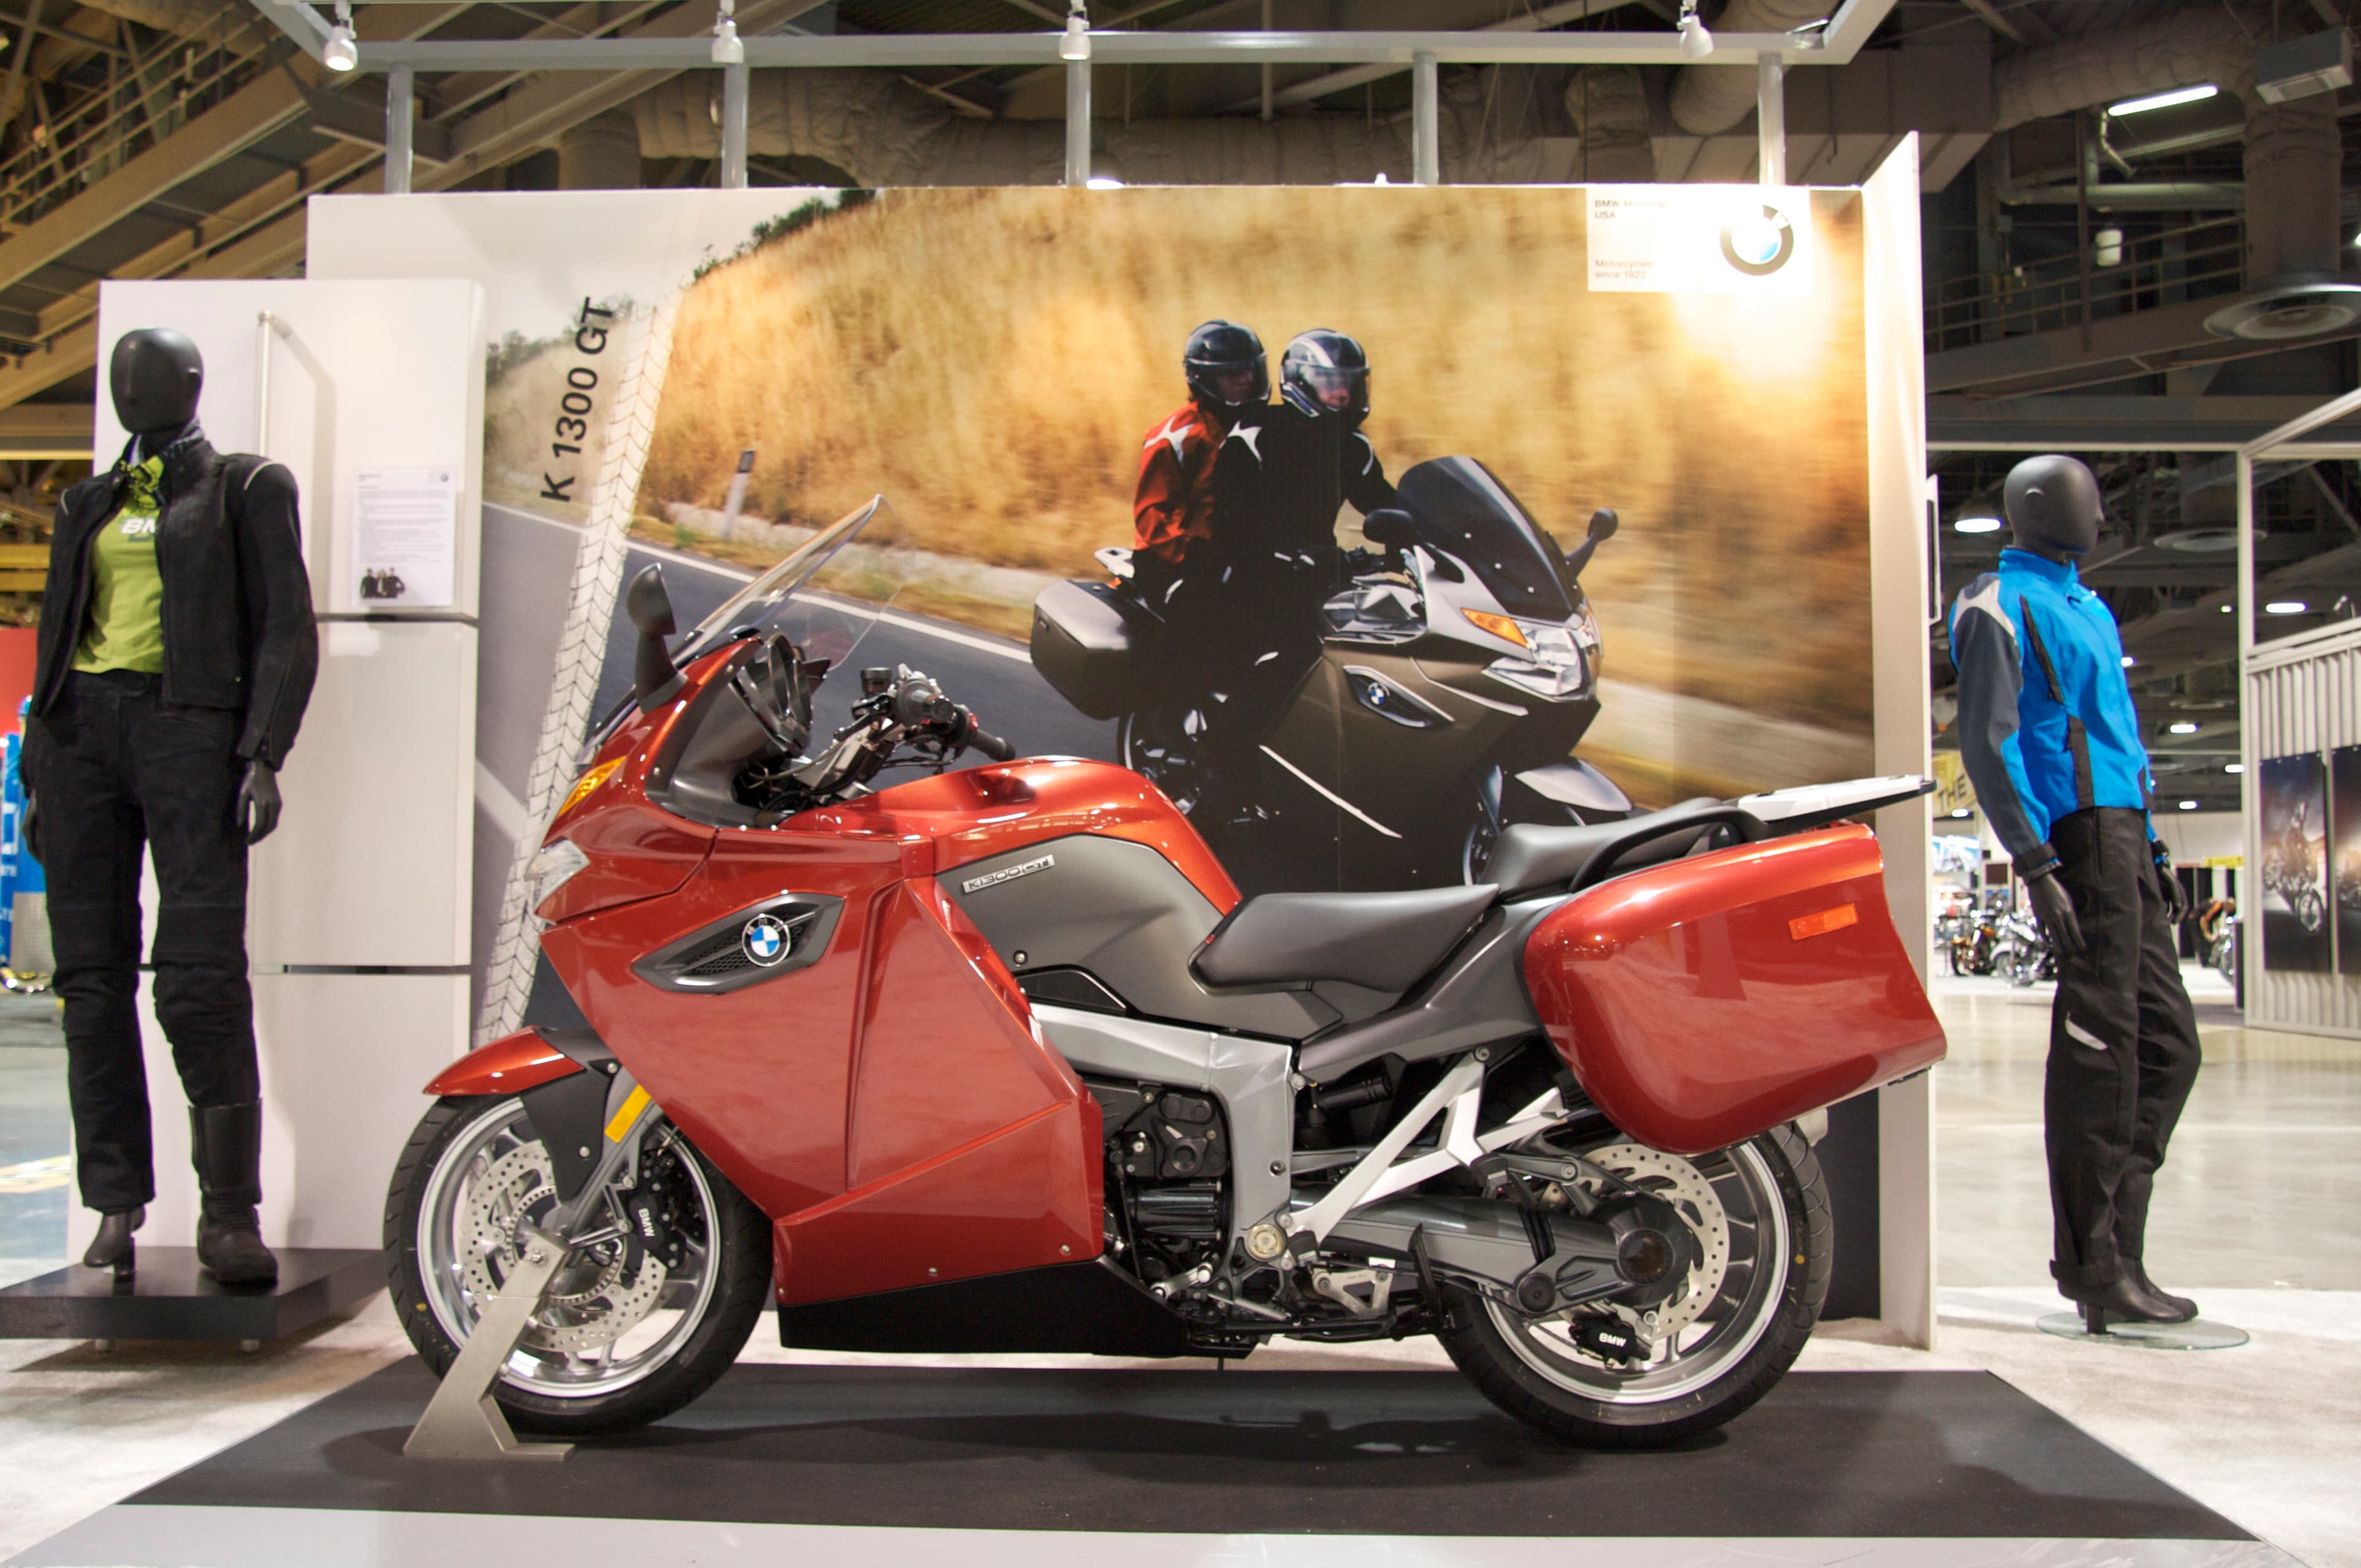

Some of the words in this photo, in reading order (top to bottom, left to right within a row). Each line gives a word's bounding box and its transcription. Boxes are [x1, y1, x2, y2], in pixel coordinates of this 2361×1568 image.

[1594, 199, 1620, 208] BMW
[1594, 210, 1616, 219] USA
[1595, 258, 1653, 269] Motorcycles
[1595, 270, 1621, 278] since
[575, 296, 614, 355] GT
[552, 366, 598, 458] 1300
[540, 472, 575, 502] K
[638, 1208, 655, 1237] BMW
[1599, 1332, 1627, 1347] BMW
